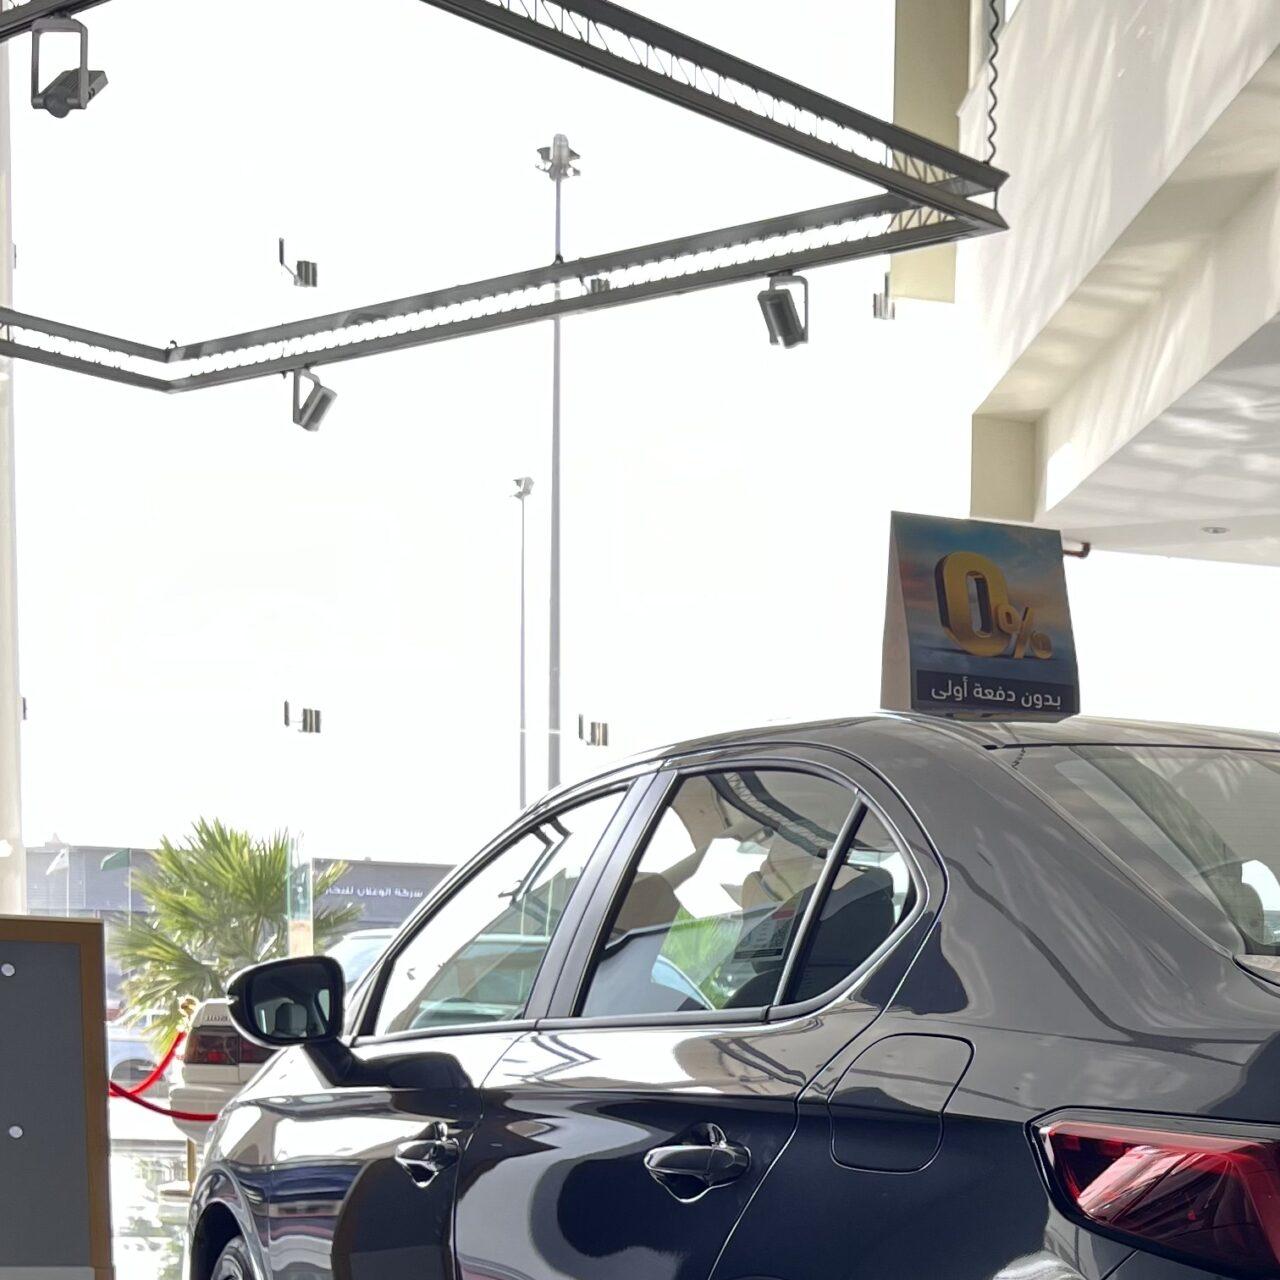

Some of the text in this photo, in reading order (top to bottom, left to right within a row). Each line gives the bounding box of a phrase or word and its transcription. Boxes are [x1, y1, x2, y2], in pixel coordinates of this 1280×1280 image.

[934, 551, 1053, 659] 0%
[931, 676, 1062, 709] بدون دفعة أولى
